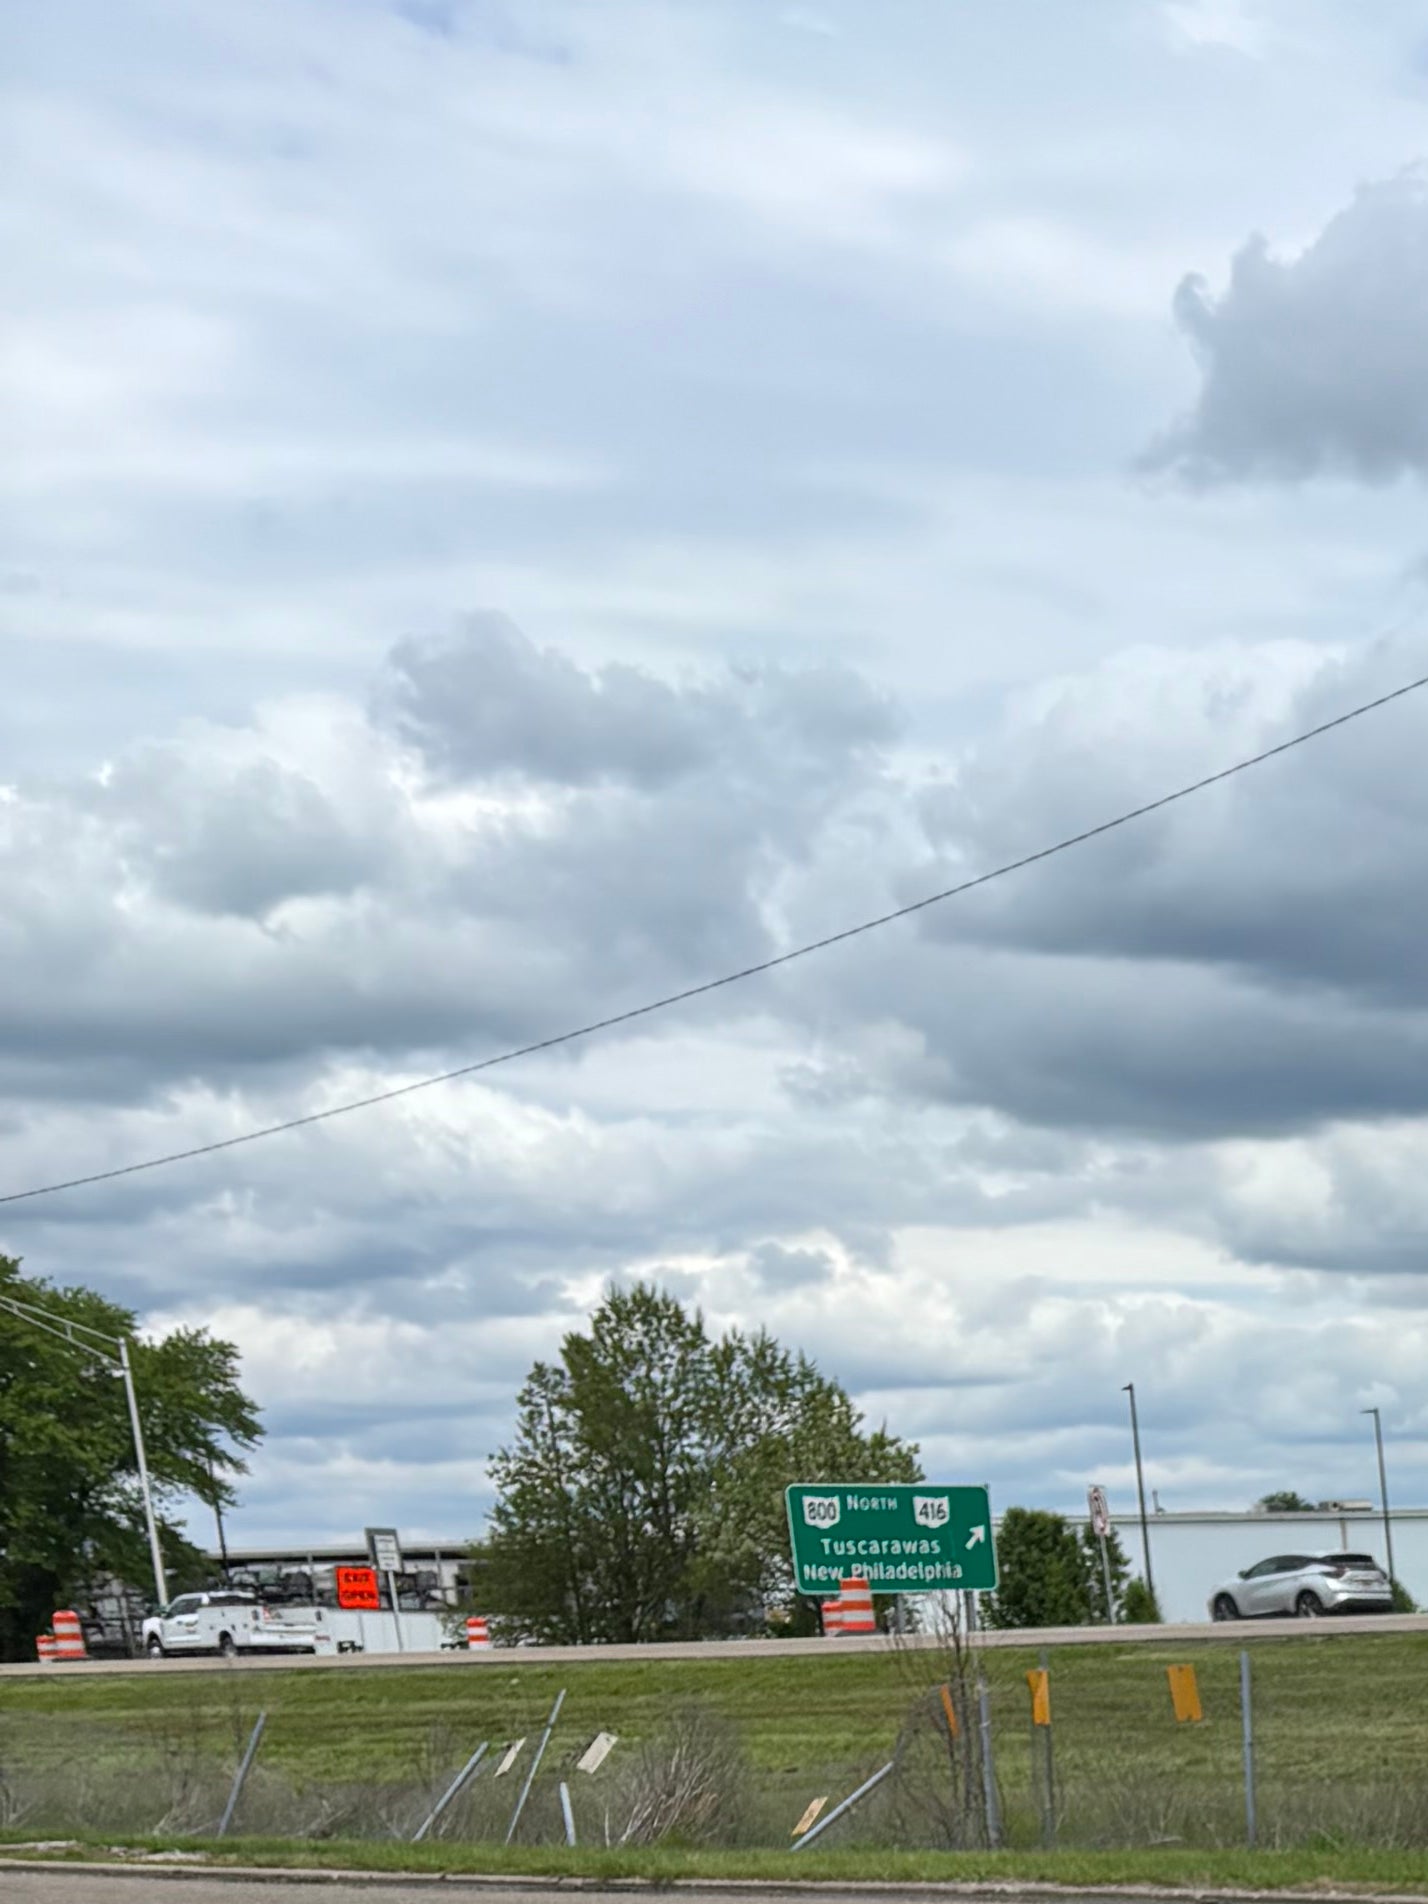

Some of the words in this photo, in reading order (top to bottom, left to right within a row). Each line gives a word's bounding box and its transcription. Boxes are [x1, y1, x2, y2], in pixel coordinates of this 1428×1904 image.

[807, 1501, 838, 1521] 800
[847, 1494, 898, 1511] NORTH
[919, 1502, 947, 1520] 416
[820, 1538, 941, 1555] Tuscarawas
[804, 1563, 843, 1581] New
[851, 1561, 963, 1583] Philadelphia
